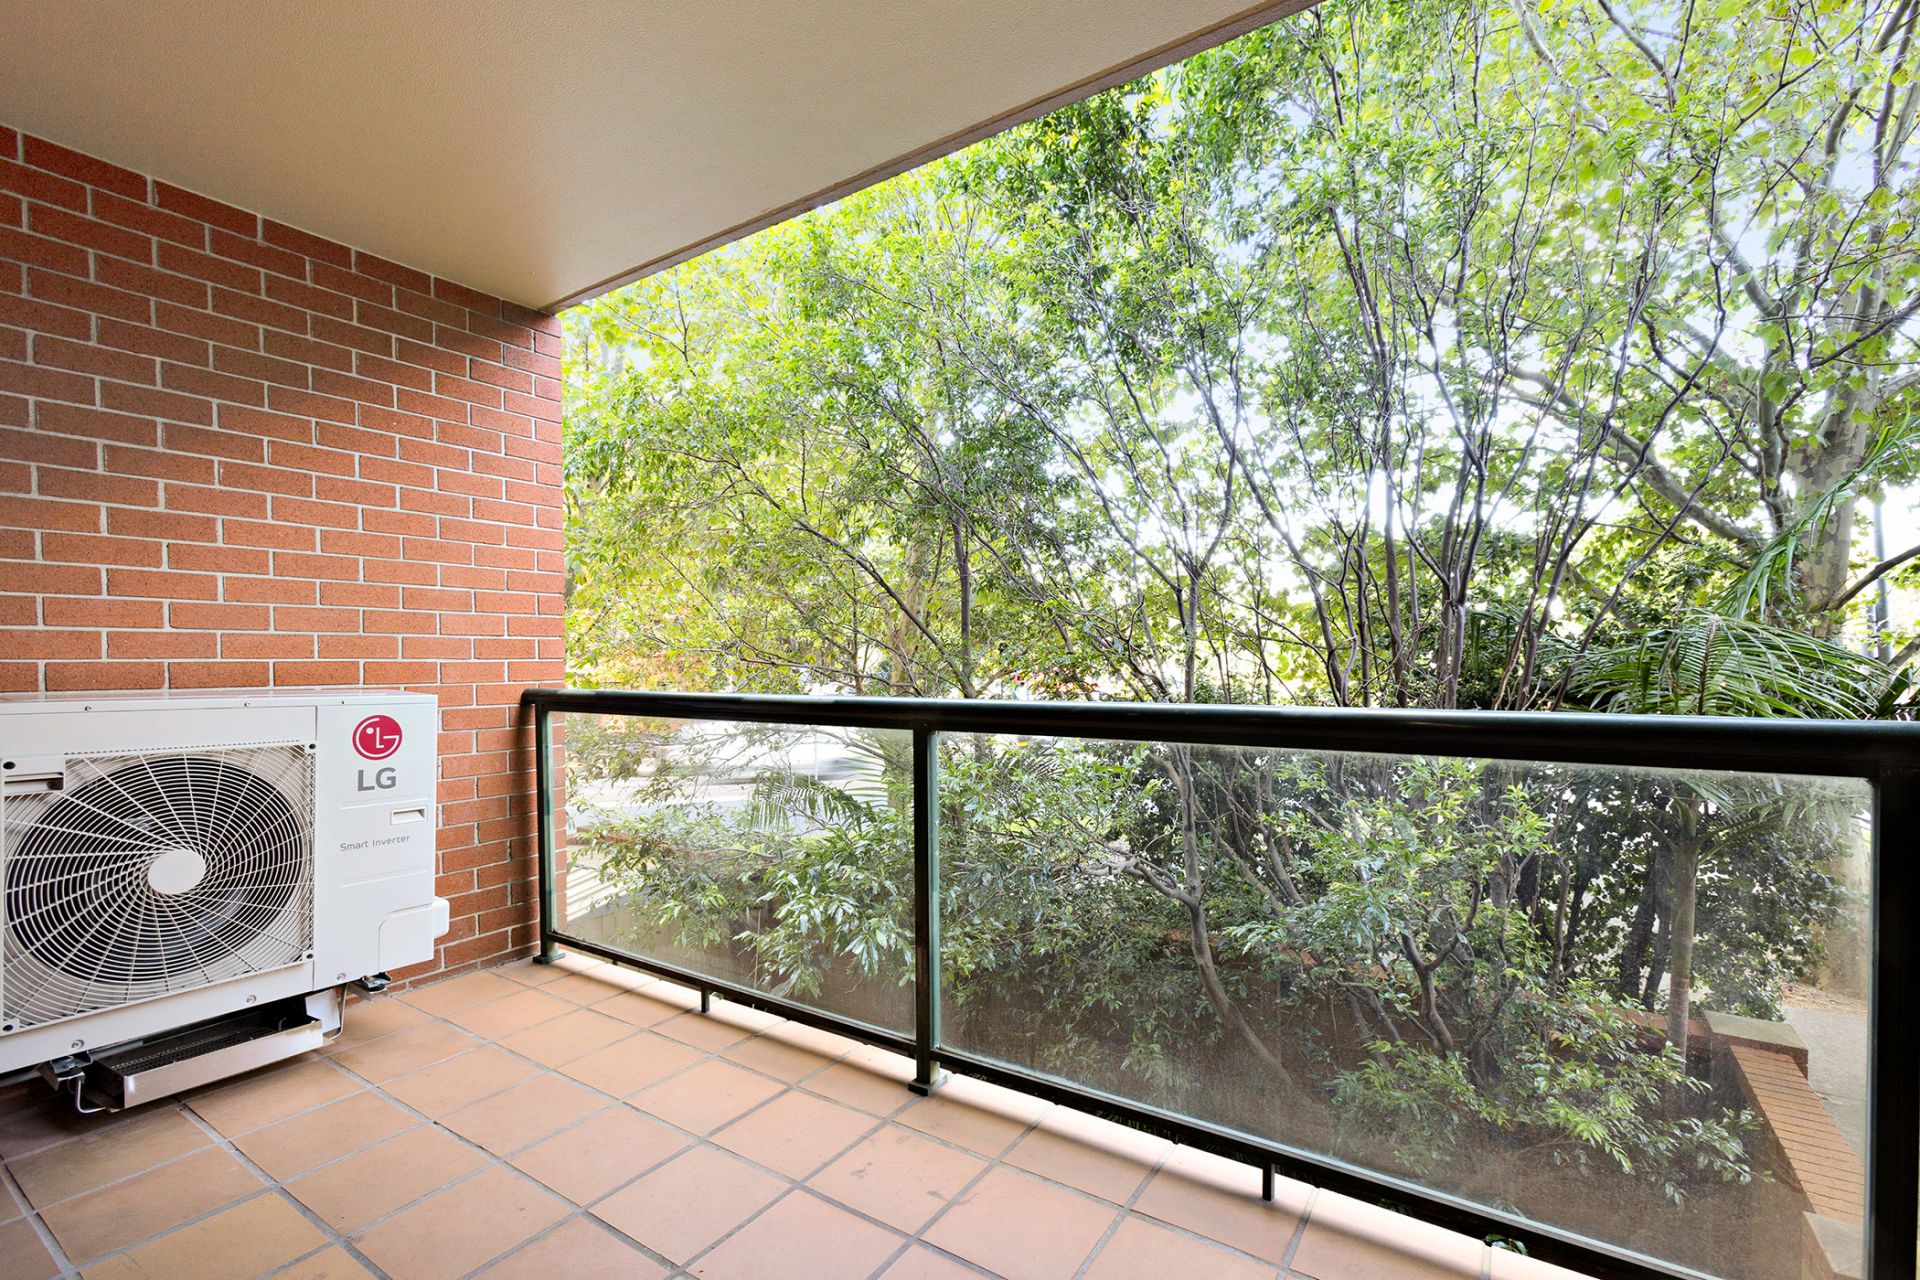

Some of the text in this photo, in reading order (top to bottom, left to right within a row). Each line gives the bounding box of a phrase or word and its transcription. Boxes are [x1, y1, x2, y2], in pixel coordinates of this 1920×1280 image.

[357, 767, 396, 791] LG
[340, 835, 410, 852] Smart Inverter
